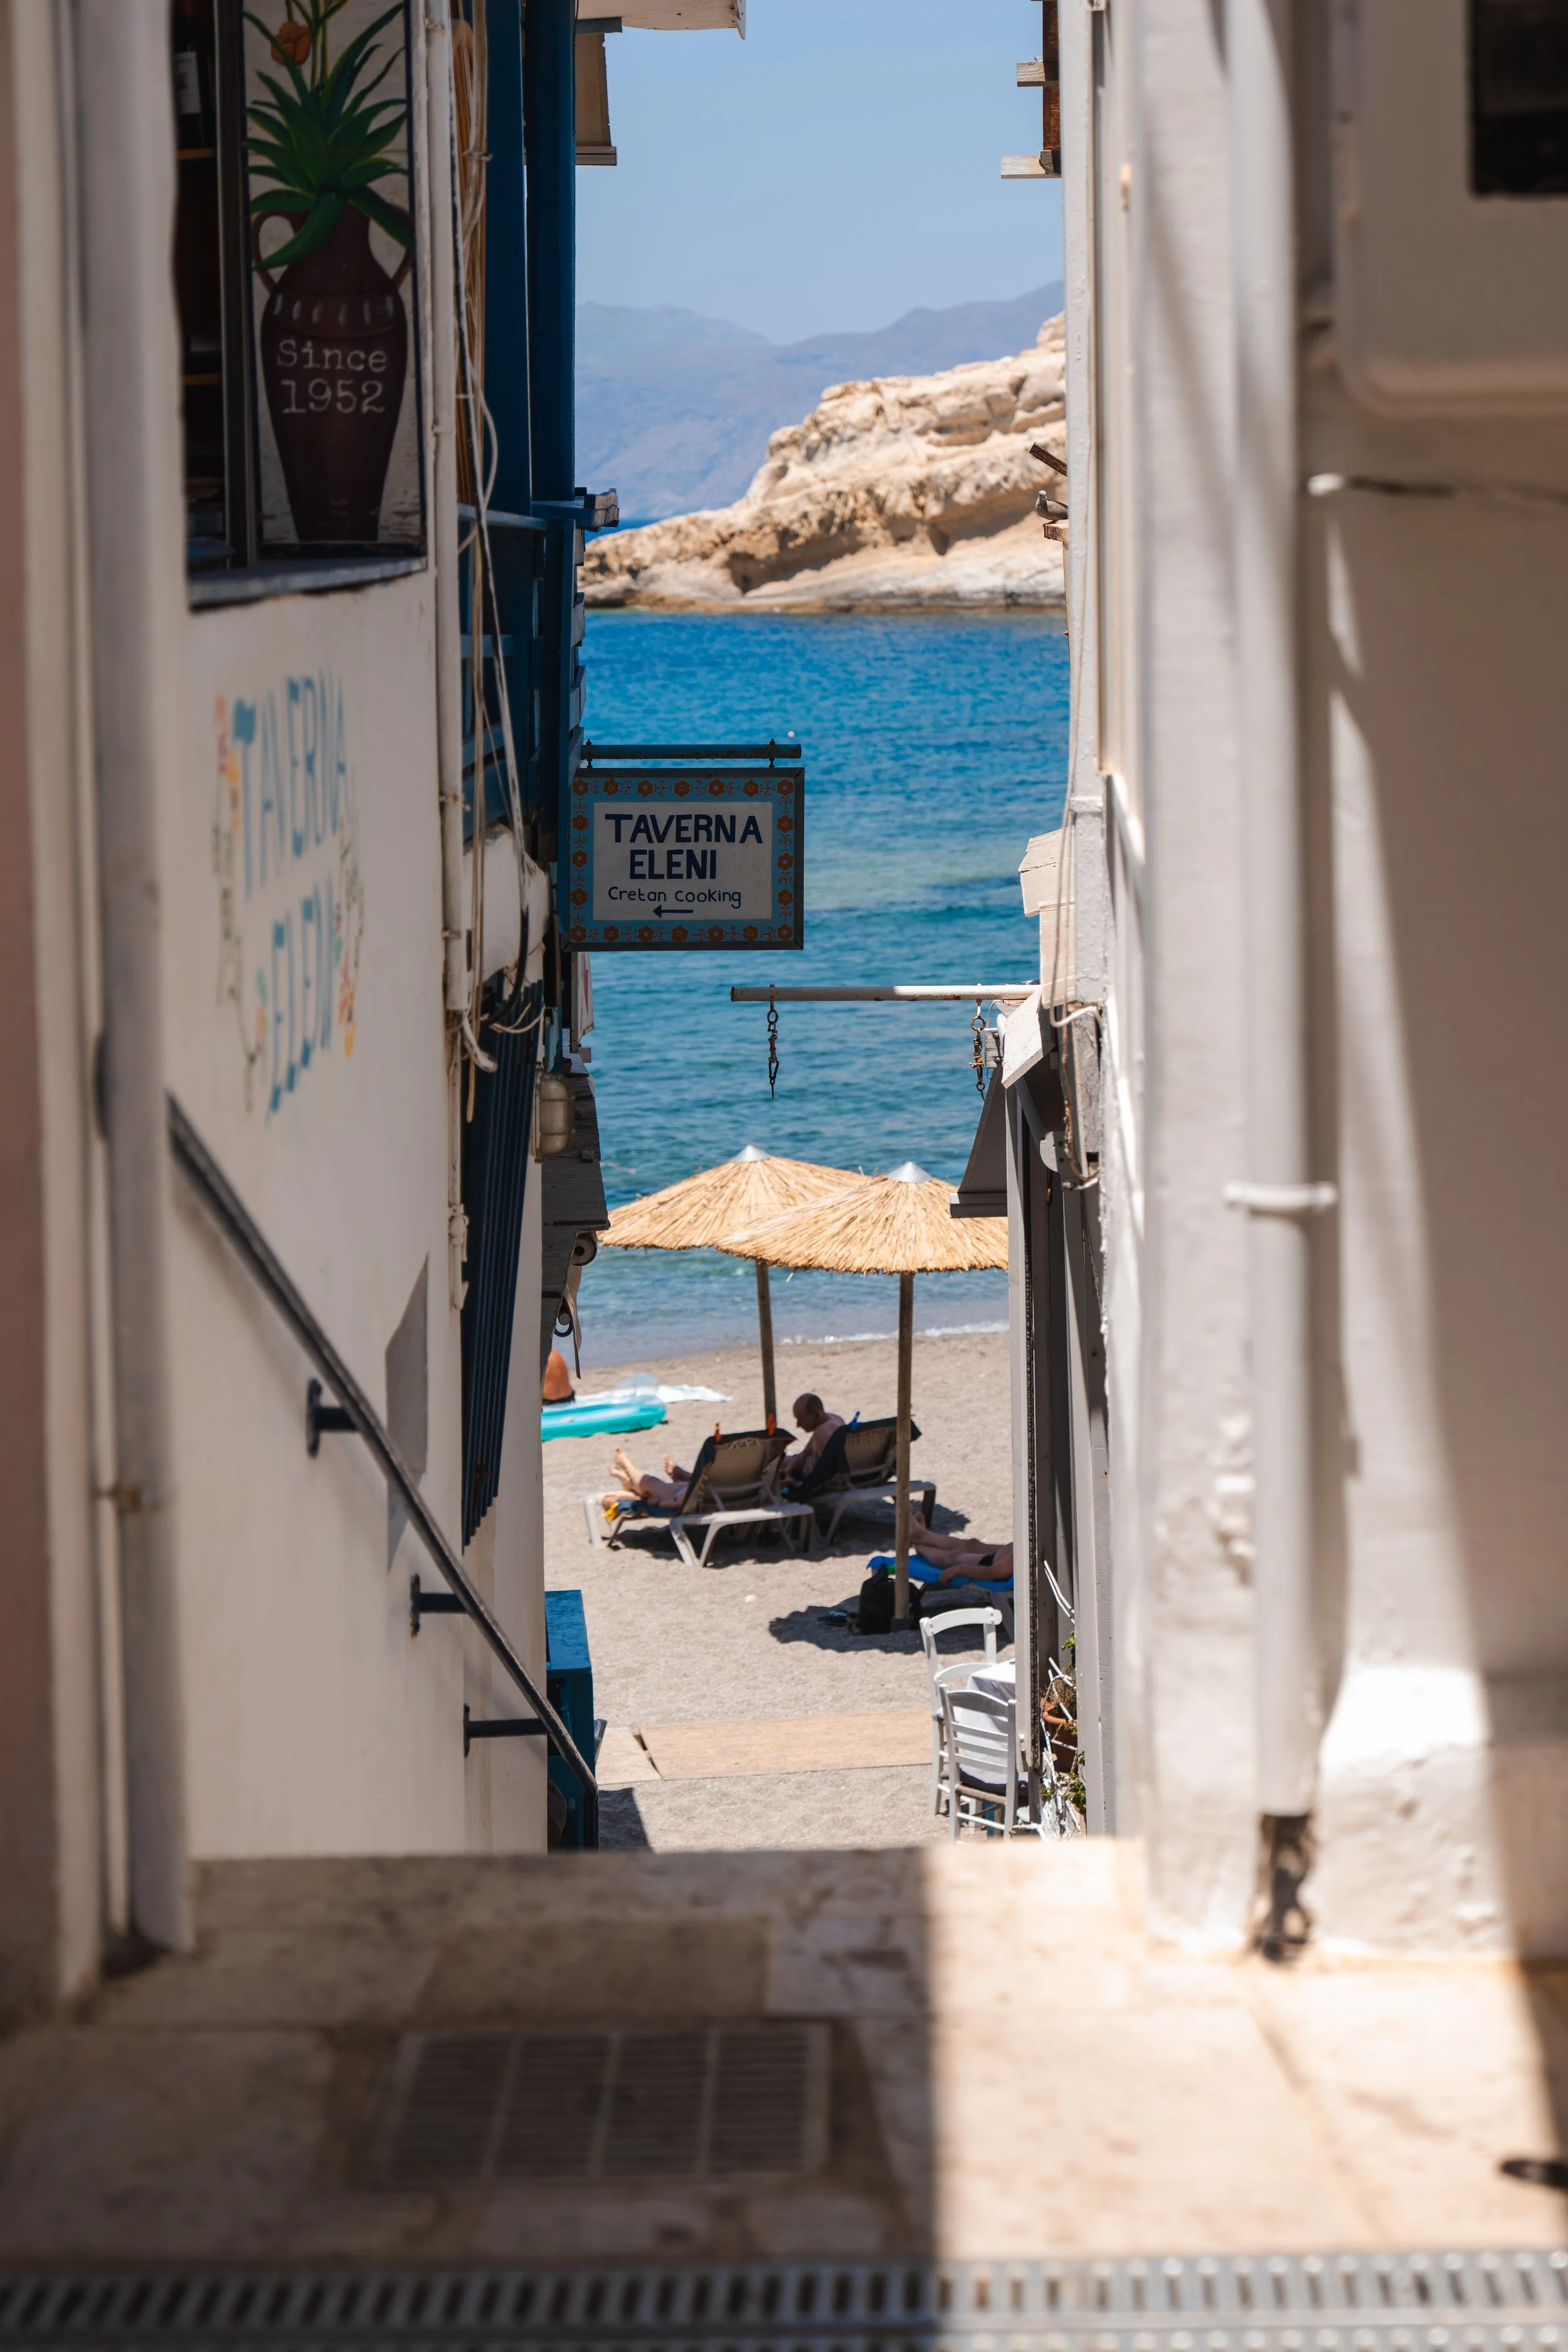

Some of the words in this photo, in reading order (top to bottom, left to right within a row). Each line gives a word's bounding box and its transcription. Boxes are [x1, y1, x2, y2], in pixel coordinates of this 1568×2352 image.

[277, 338, 387, 373] Since
[281, 378, 385, 414] 1952
[605, 813, 763, 844] TAVERNA
[629, 849, 717, 880] ELENI
[608, 886, 667, 902] Cretan
